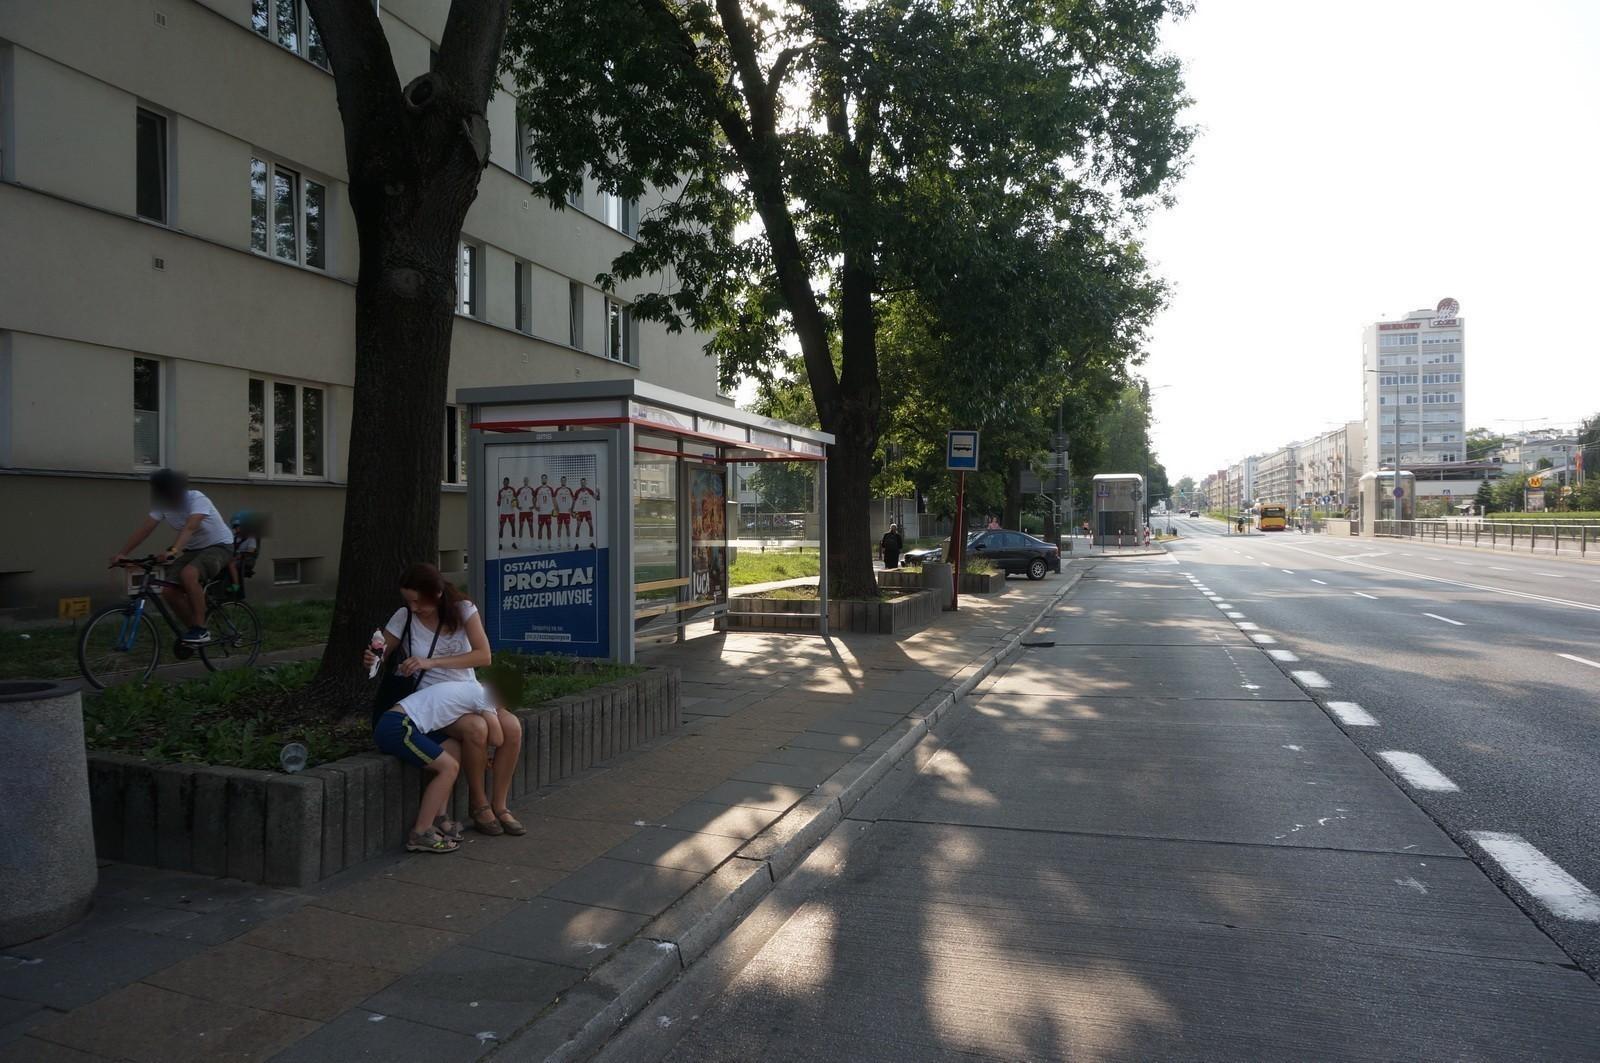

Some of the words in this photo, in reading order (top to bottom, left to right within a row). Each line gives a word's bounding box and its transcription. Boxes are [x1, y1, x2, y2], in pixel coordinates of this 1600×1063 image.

[504, 559, 557, 573] OSTATNIA
[503, 566, 593, 592] PROSTA!
[693, 571, 711, 600] LUCA
[502, 588, 593, 611] #SZCZEPIMYSIĘ
